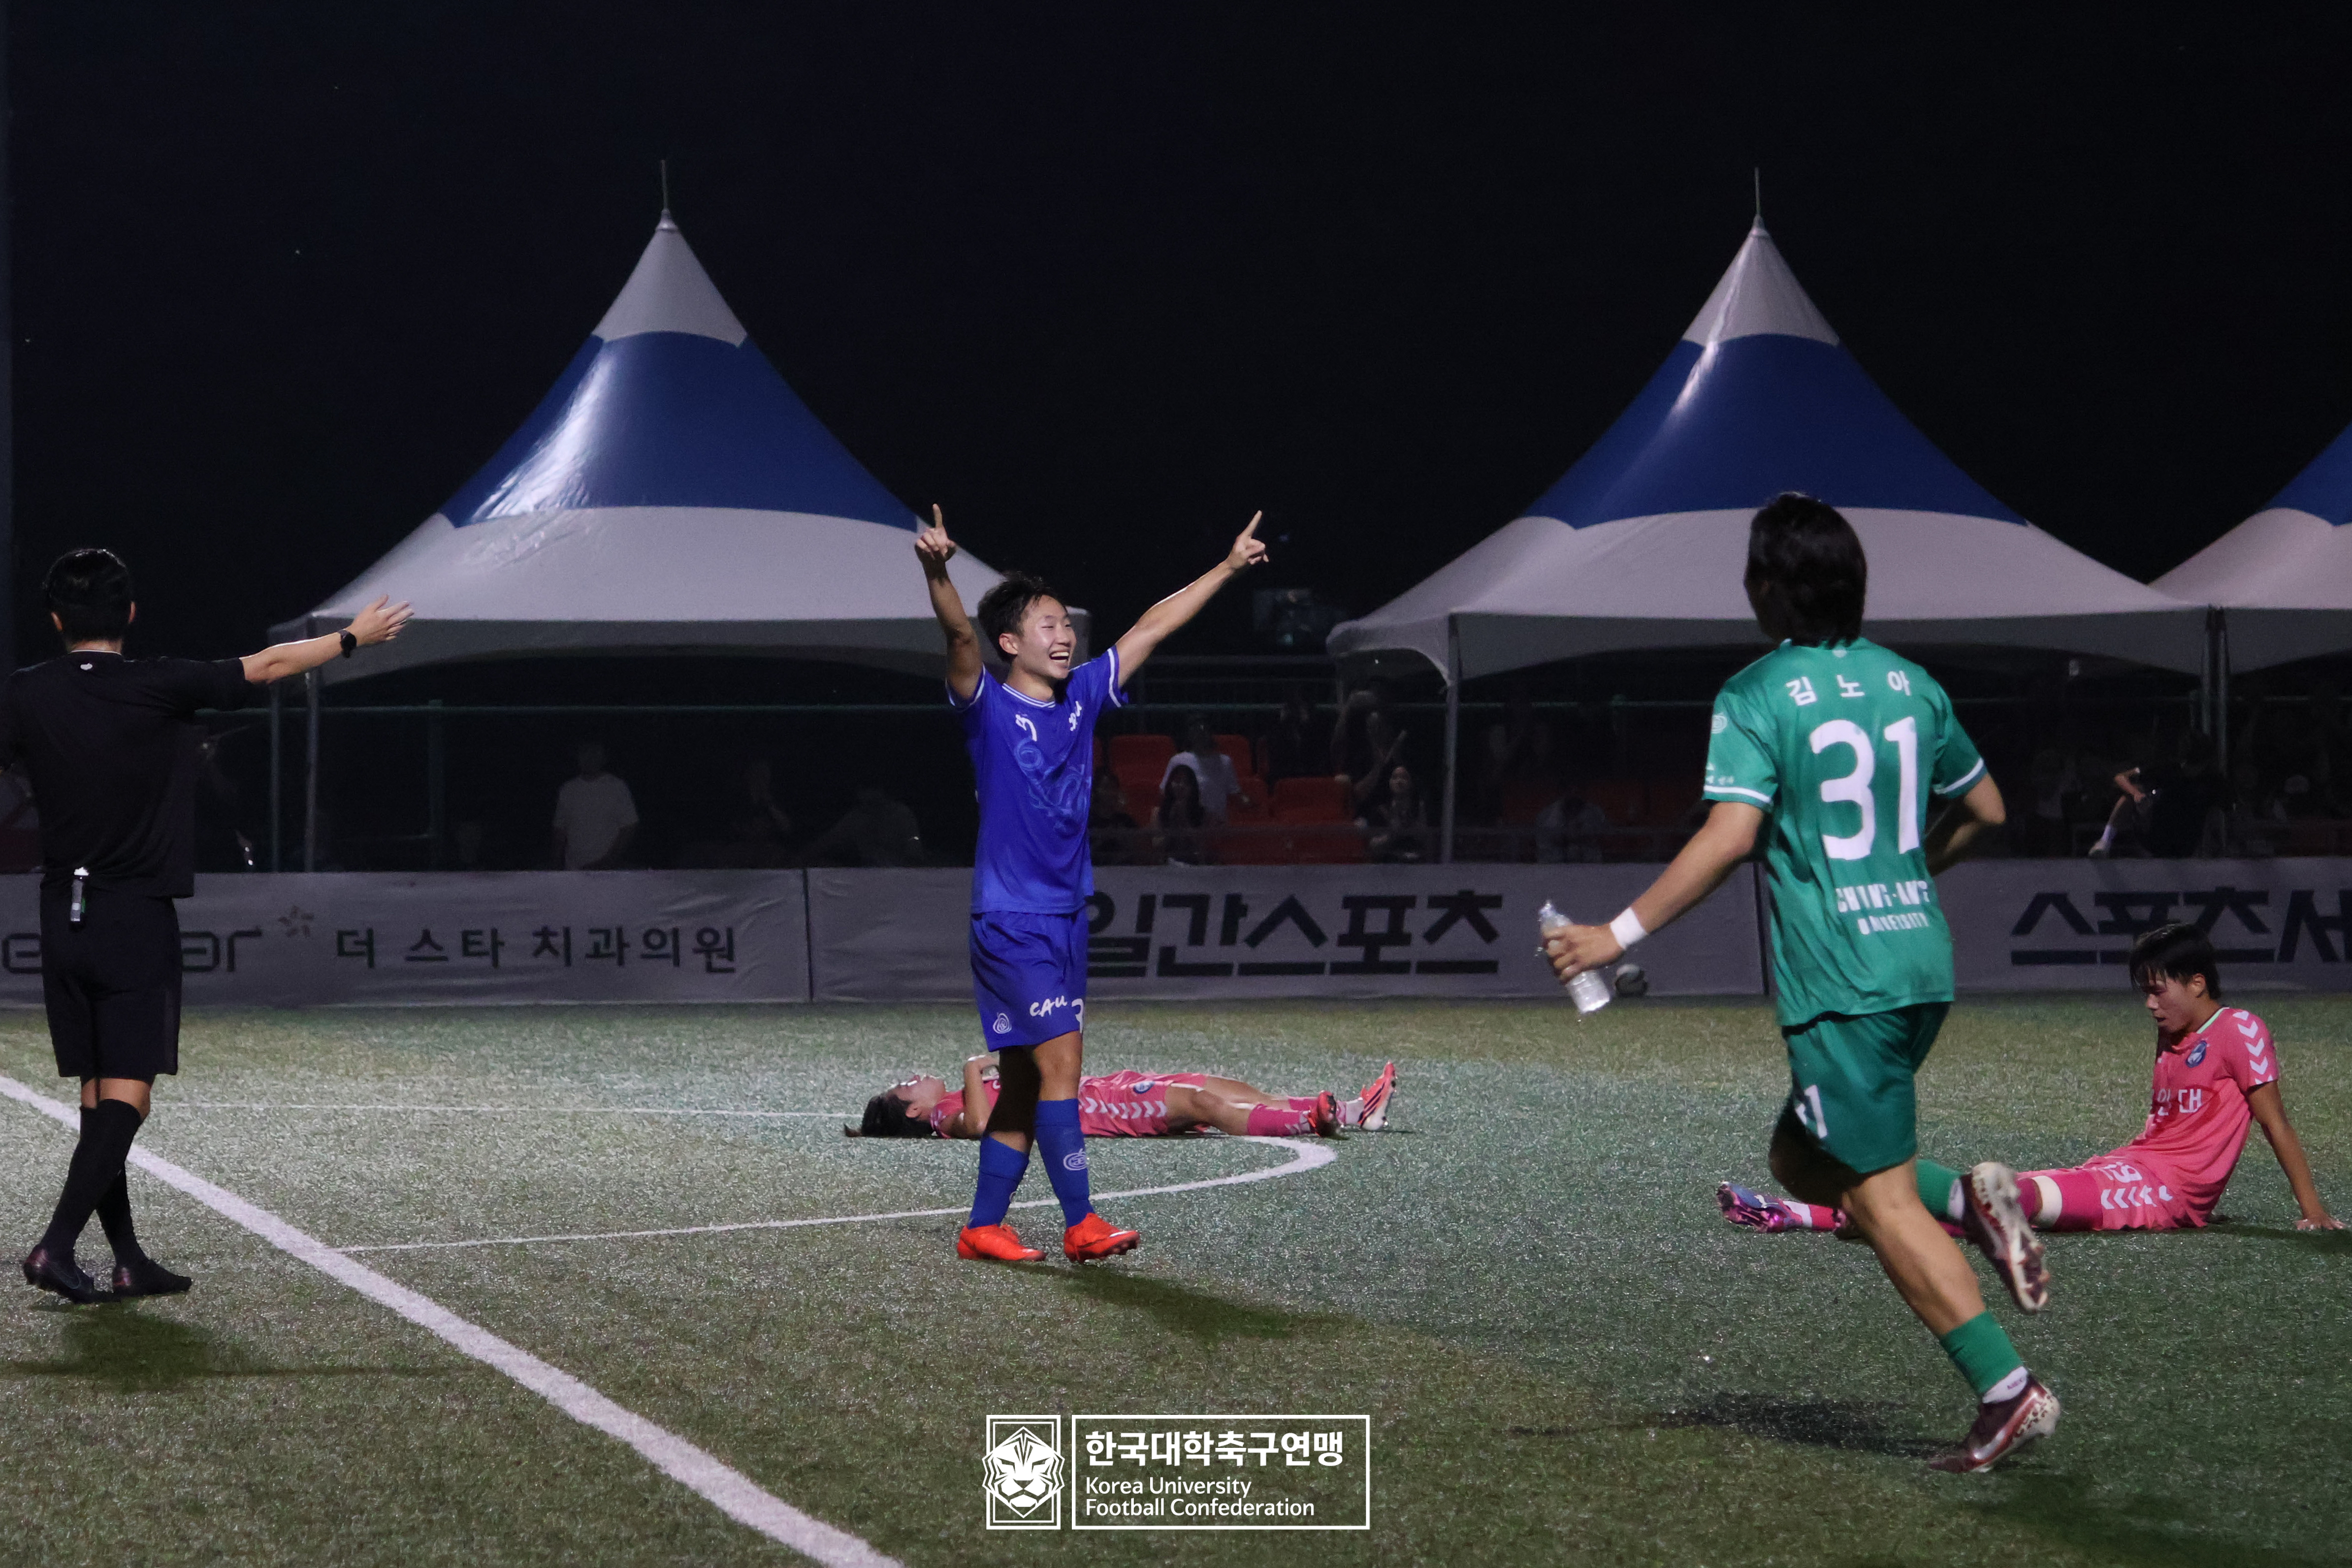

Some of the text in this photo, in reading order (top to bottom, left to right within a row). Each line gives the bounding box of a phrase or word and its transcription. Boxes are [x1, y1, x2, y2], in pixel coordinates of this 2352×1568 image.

[1809, 716, 1920, 861] 31
[337, 925, 737, 974] 더 스타 치과의원
[1086, 890, 1503, 977] 일간스포츠
